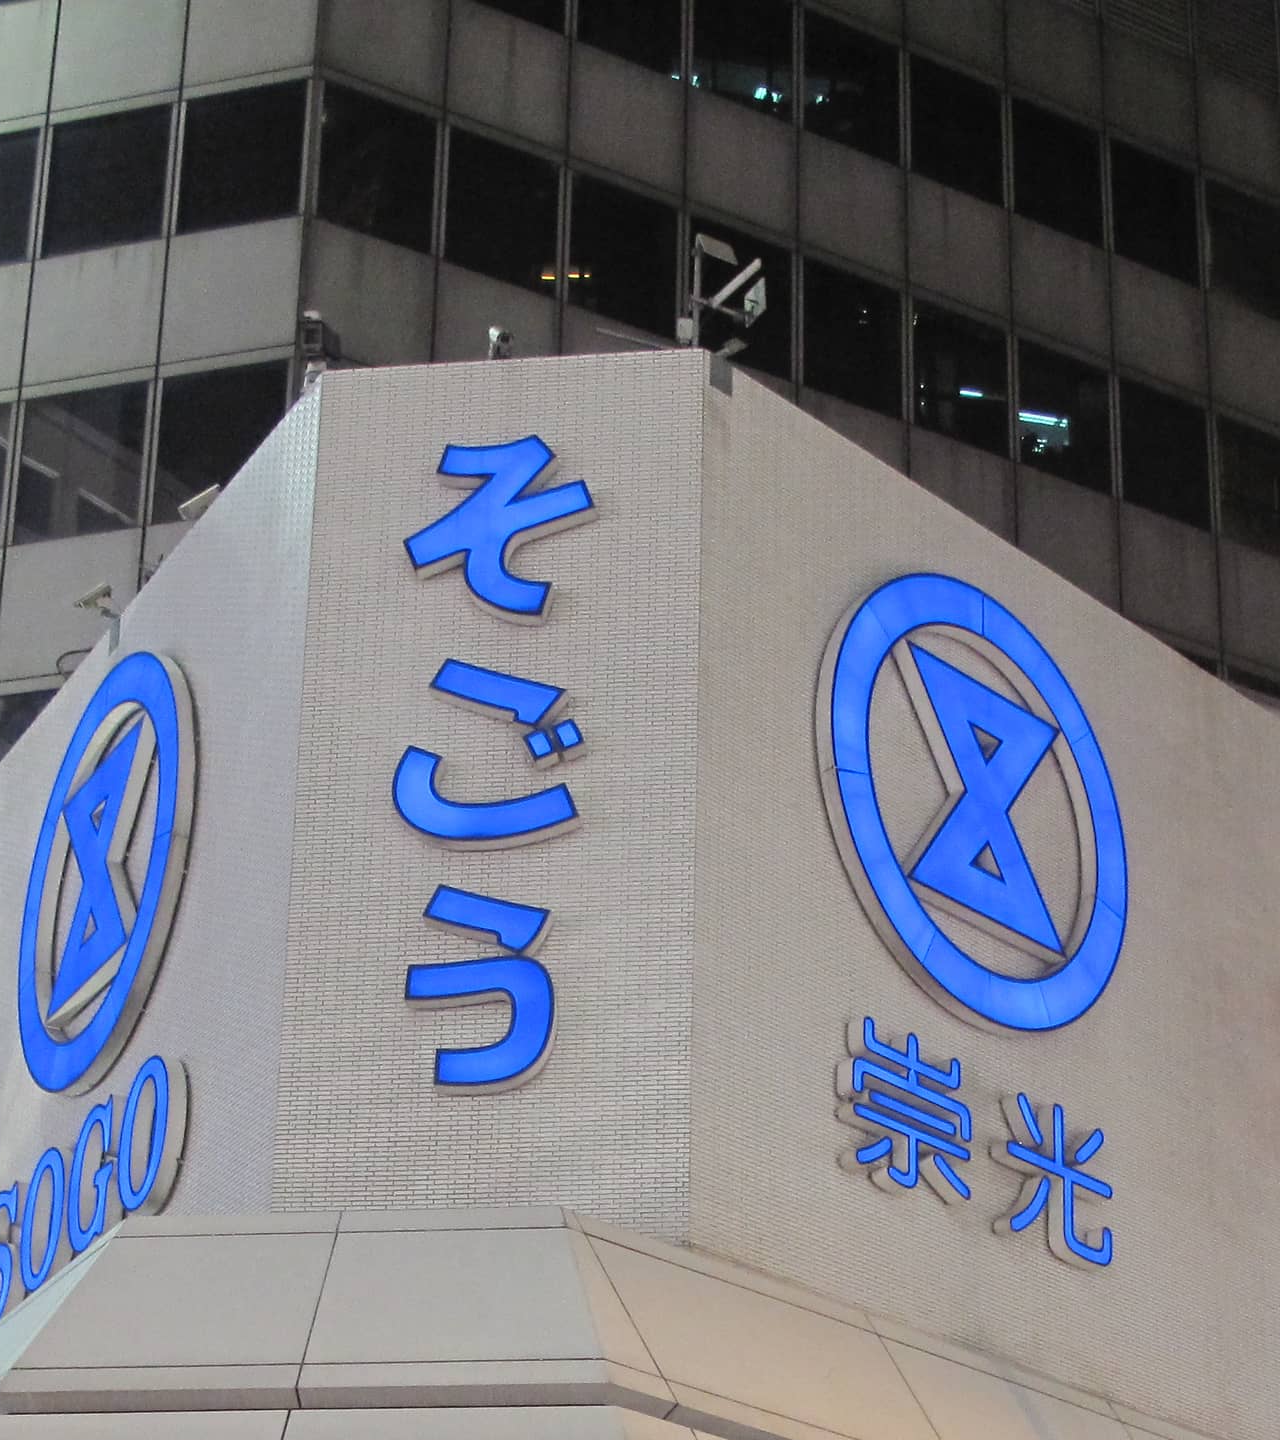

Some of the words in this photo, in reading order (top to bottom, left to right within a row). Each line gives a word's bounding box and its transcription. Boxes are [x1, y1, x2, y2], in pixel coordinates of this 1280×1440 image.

[392, 433, 596, 1089] そごう
[848, 1014, 1115, 1268] 崇光
